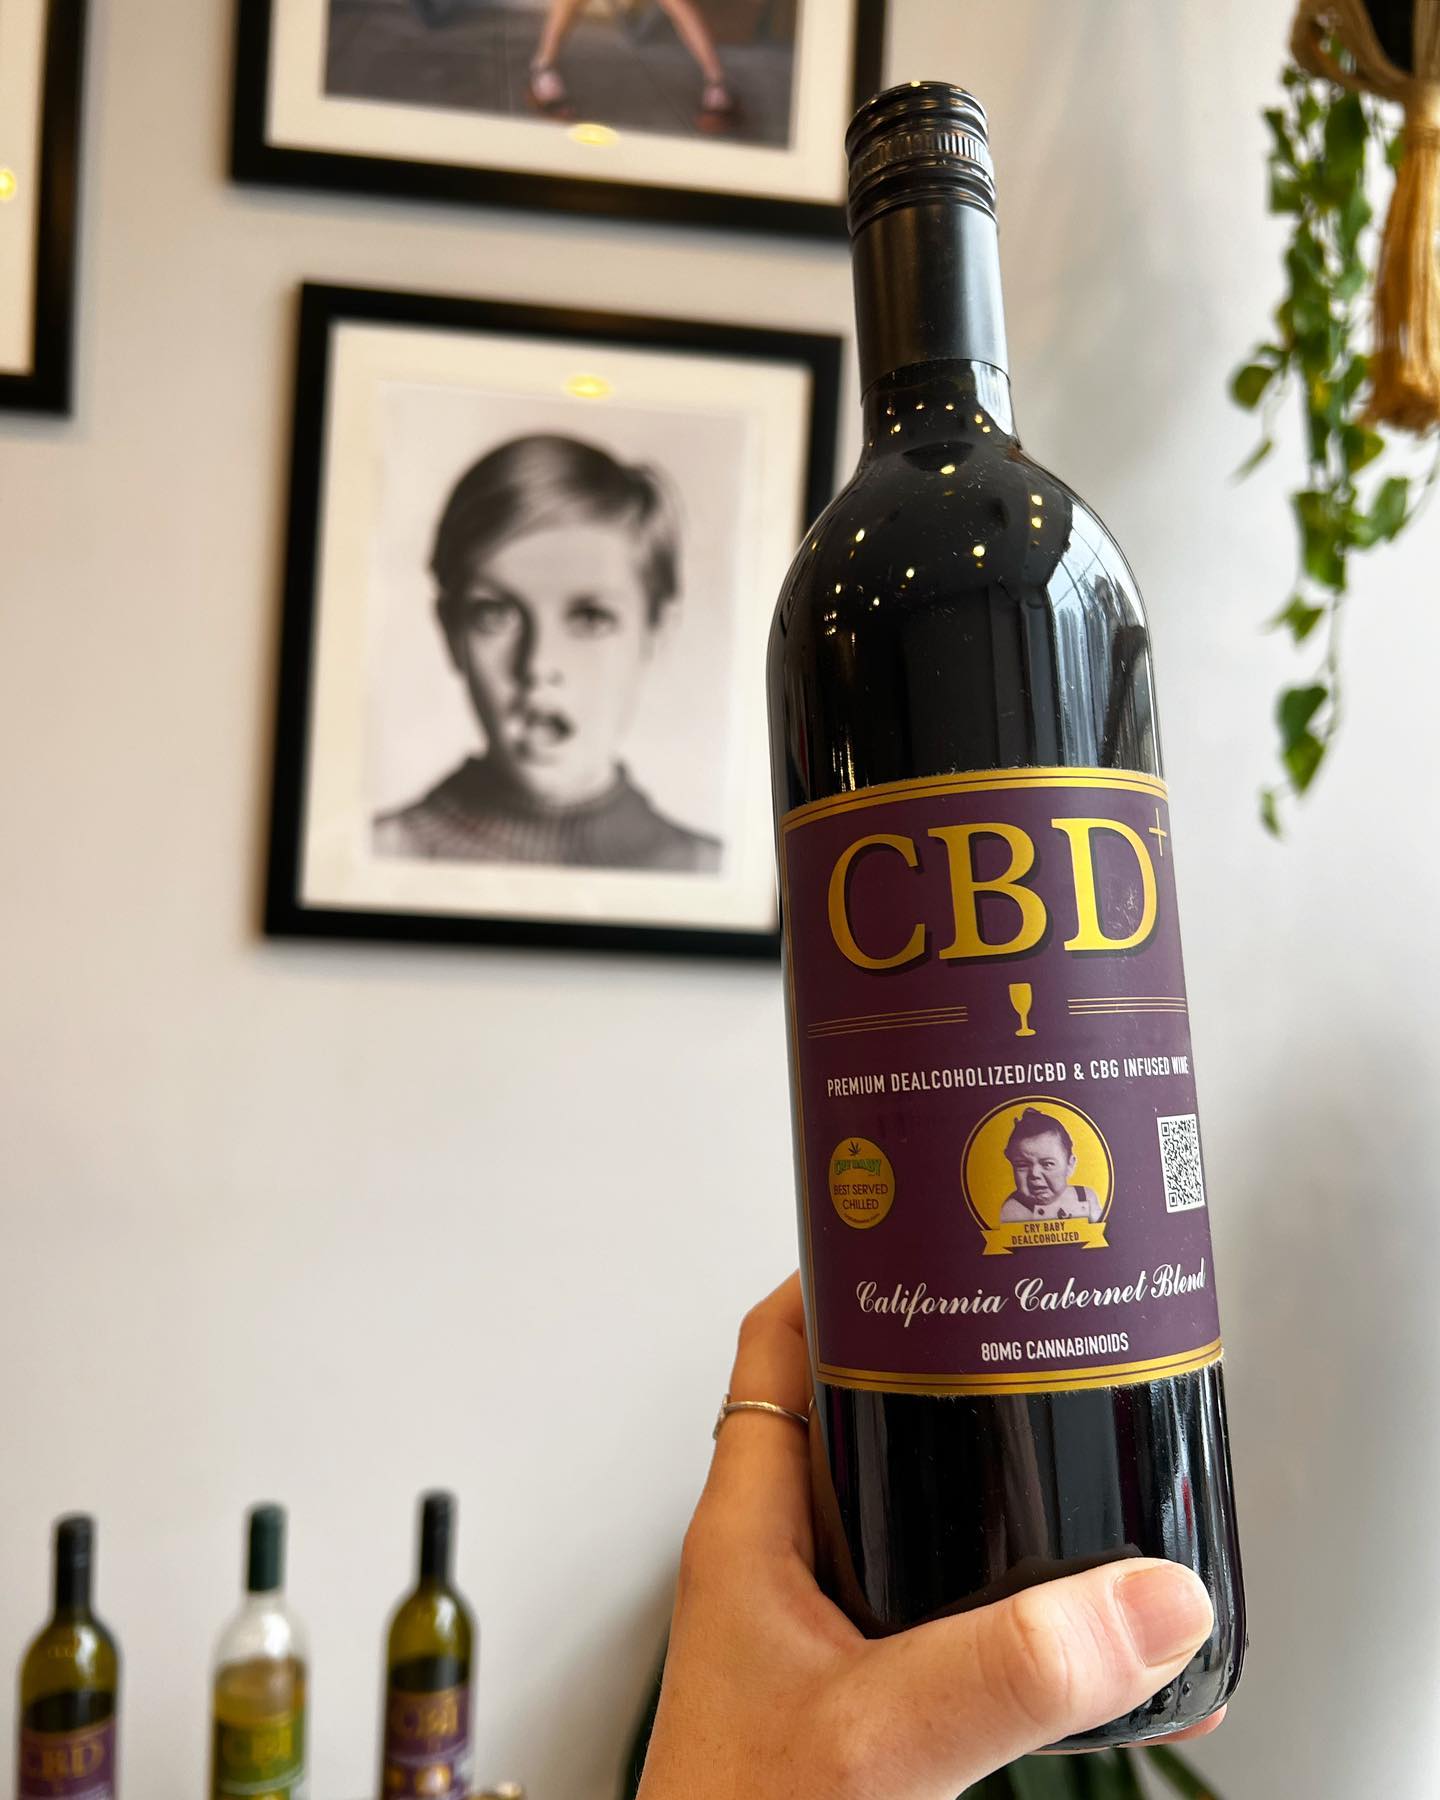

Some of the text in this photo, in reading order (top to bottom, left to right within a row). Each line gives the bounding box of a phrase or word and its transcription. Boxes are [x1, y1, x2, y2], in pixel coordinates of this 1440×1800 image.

[827, 1055, 1189, 1097] PREMIUM DEALCOHOLIZED/CBD & CBG INFUSED WINE
[833, 1183, 888, 1196] BEST SERVED
[842, 1199, 879, 1210] CHILLED
[1024, 1221, 1065, 1233] CRY BABY
[1011, 1231, 1079, 1245] DEALCOHOLIZED
[856, 1257, 1206, 1327] California Cabernet Blend
[981, 1331, 1129, 1362] 80MG CANNABINOIDS
